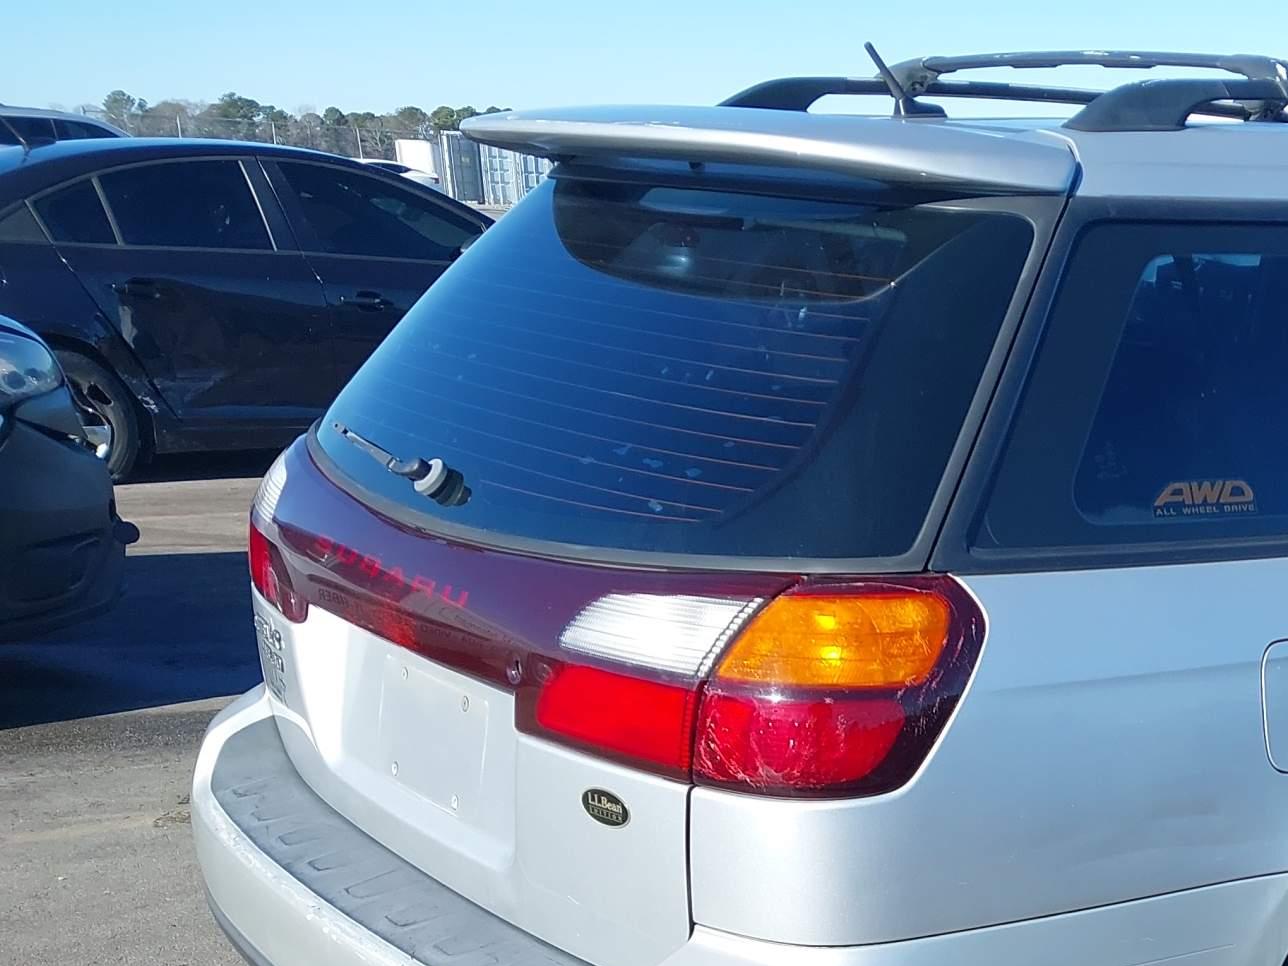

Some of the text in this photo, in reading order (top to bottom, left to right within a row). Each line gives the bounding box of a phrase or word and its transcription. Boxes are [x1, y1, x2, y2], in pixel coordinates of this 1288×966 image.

[1154, 480, 1254, 506] AWD
[1155, 503, 1255, 517] ALL WHEEL DRIVE
[314, 535, 470, 609] SUBARU
